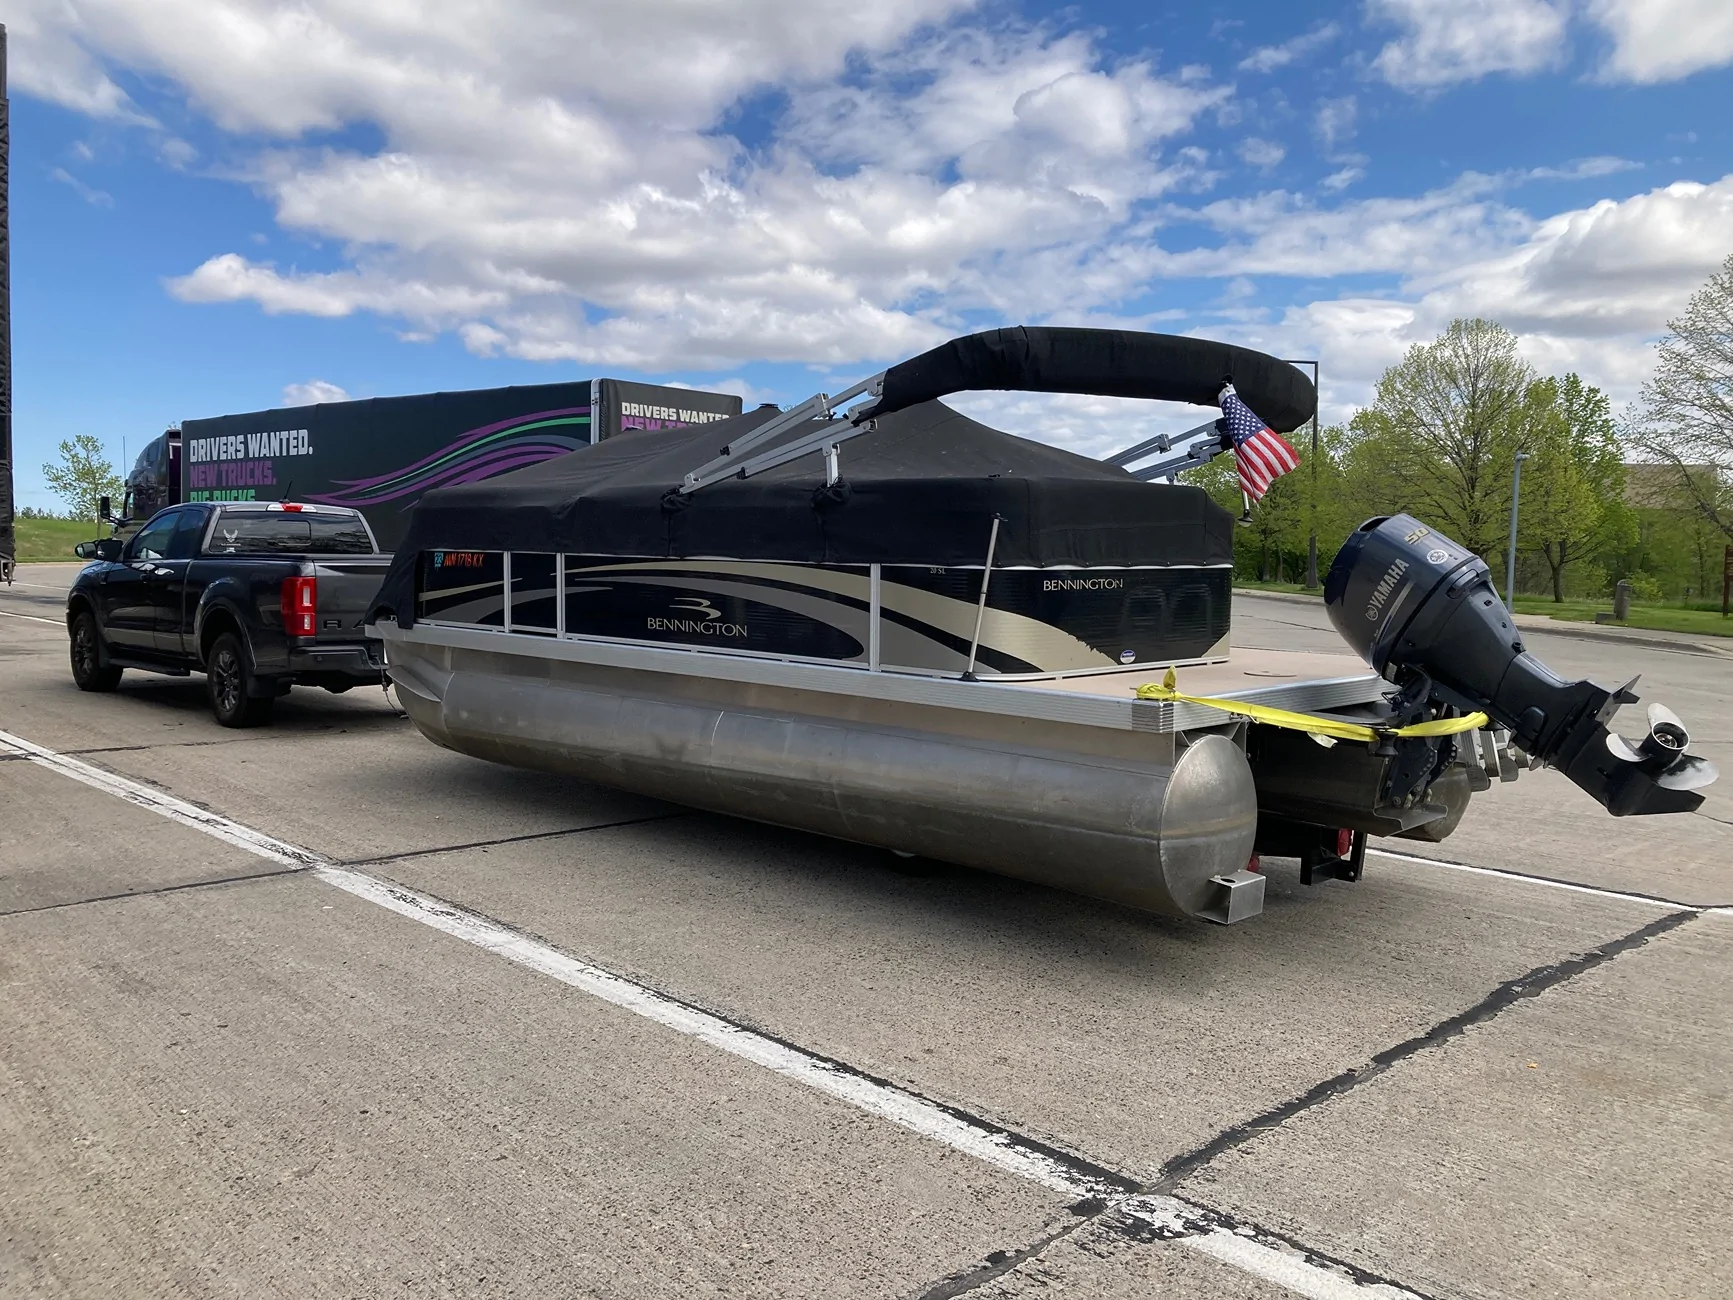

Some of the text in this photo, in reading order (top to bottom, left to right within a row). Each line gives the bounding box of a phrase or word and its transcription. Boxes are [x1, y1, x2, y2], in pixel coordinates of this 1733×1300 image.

[621, 402, 677, 421] DRIVERS
[189, 429, 313, 463] DRIVERS WANTED.
[189, 461, 277, 488] NEW TRUCKS.
[1404, 527, 1430, 544] 50
[1043, 578, 1124, 591] BENNINGTON
[1369, 558, 1410, 609] YAMAHA
[647, 617, 747, 637] BENNINGTON
